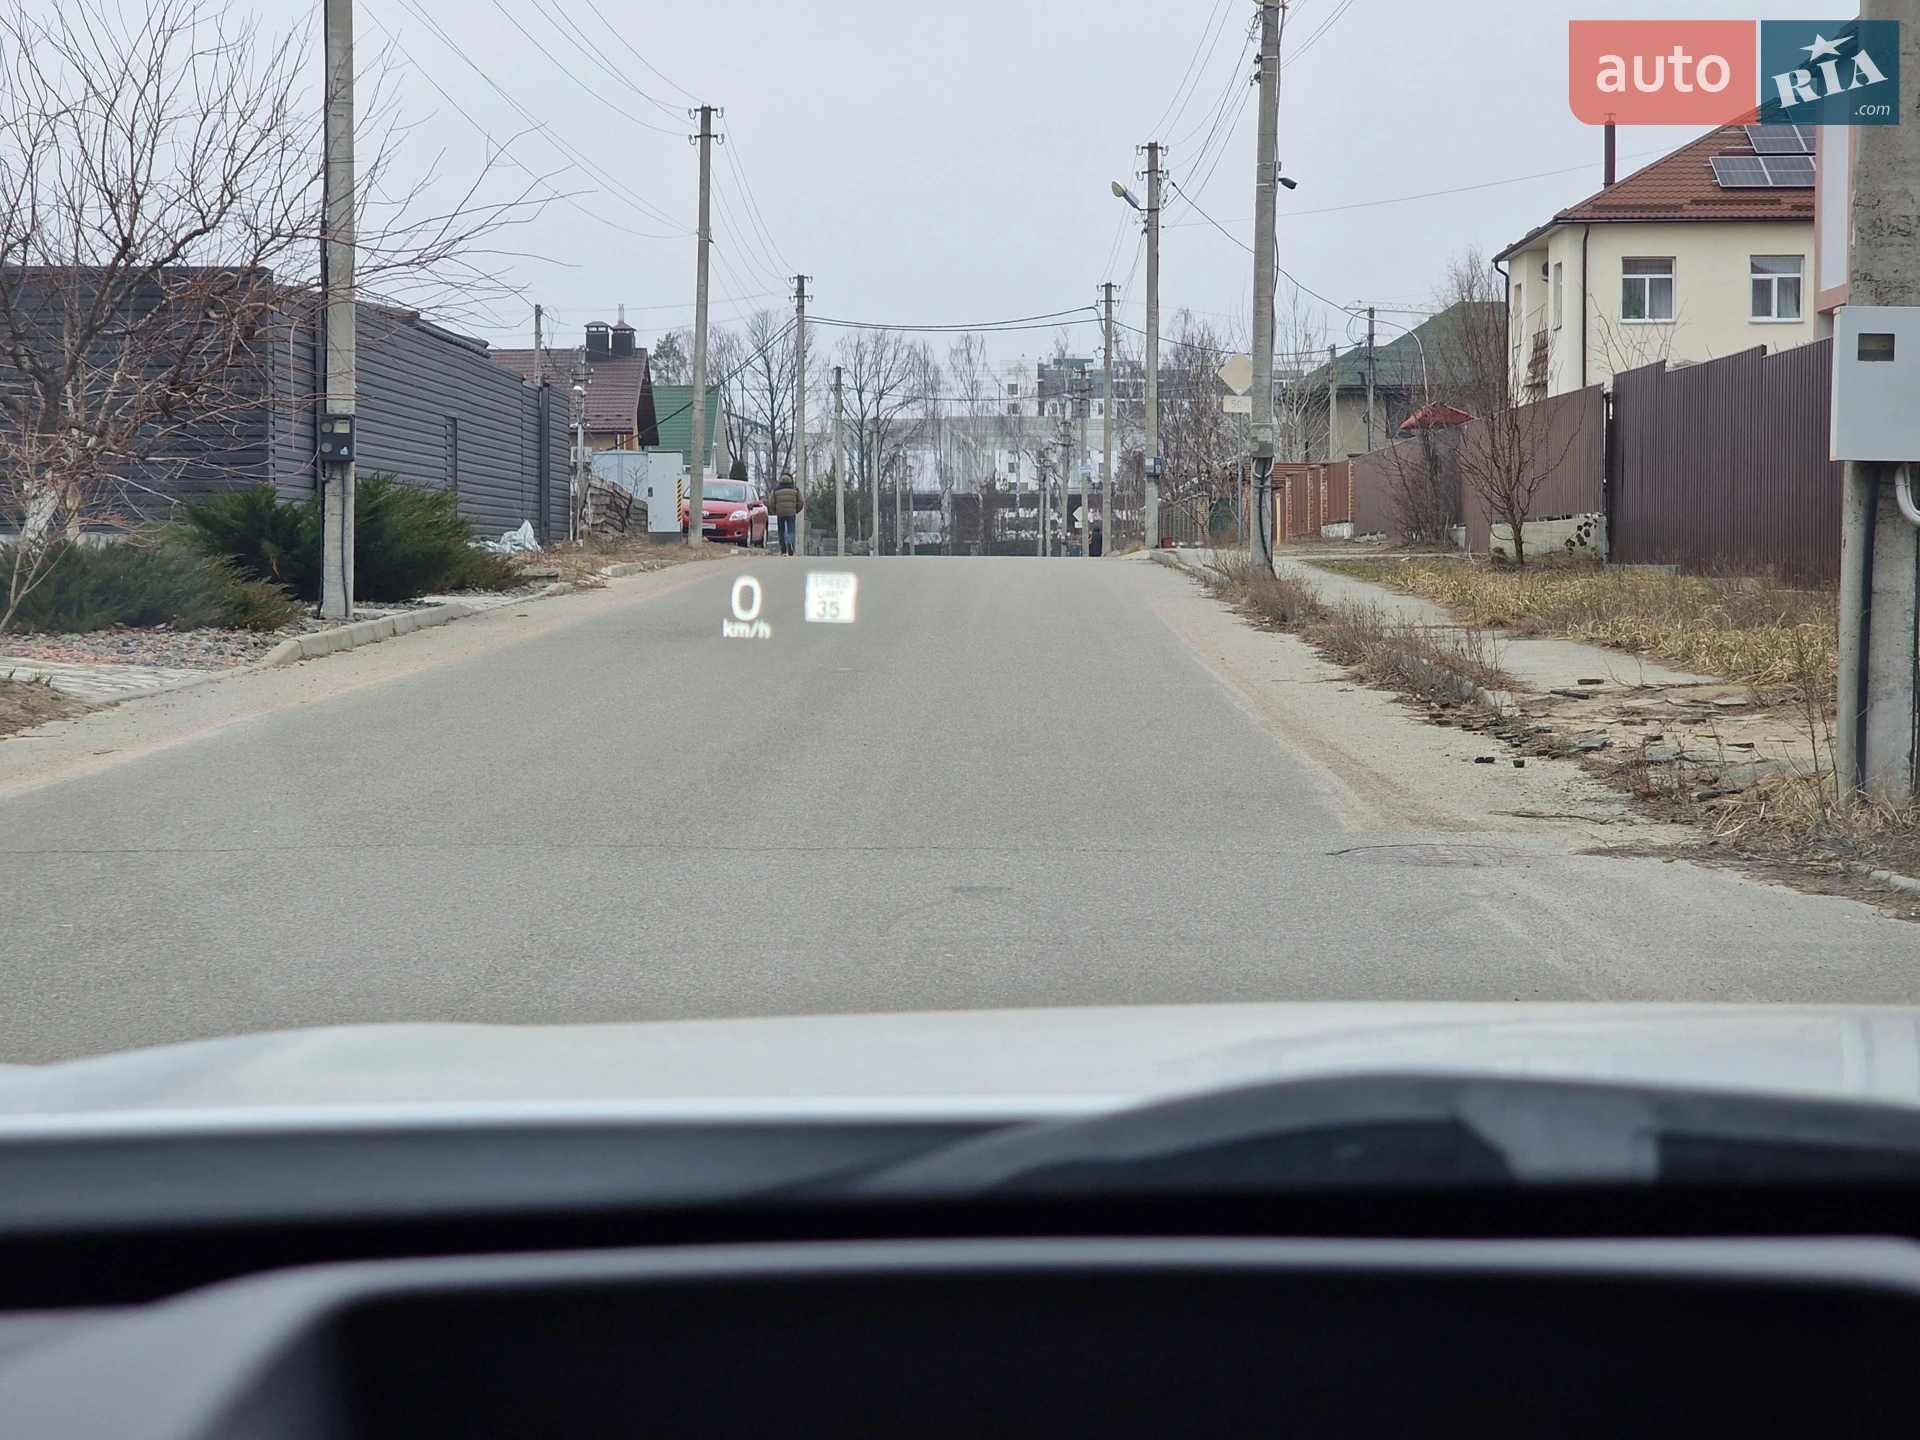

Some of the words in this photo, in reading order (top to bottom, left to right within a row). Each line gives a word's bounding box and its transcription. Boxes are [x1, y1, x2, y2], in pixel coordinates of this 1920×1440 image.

[732, 576, 761, 619] 0
[816, 600, 841, 618] 35
[722, 618, 770, 639] km/h
